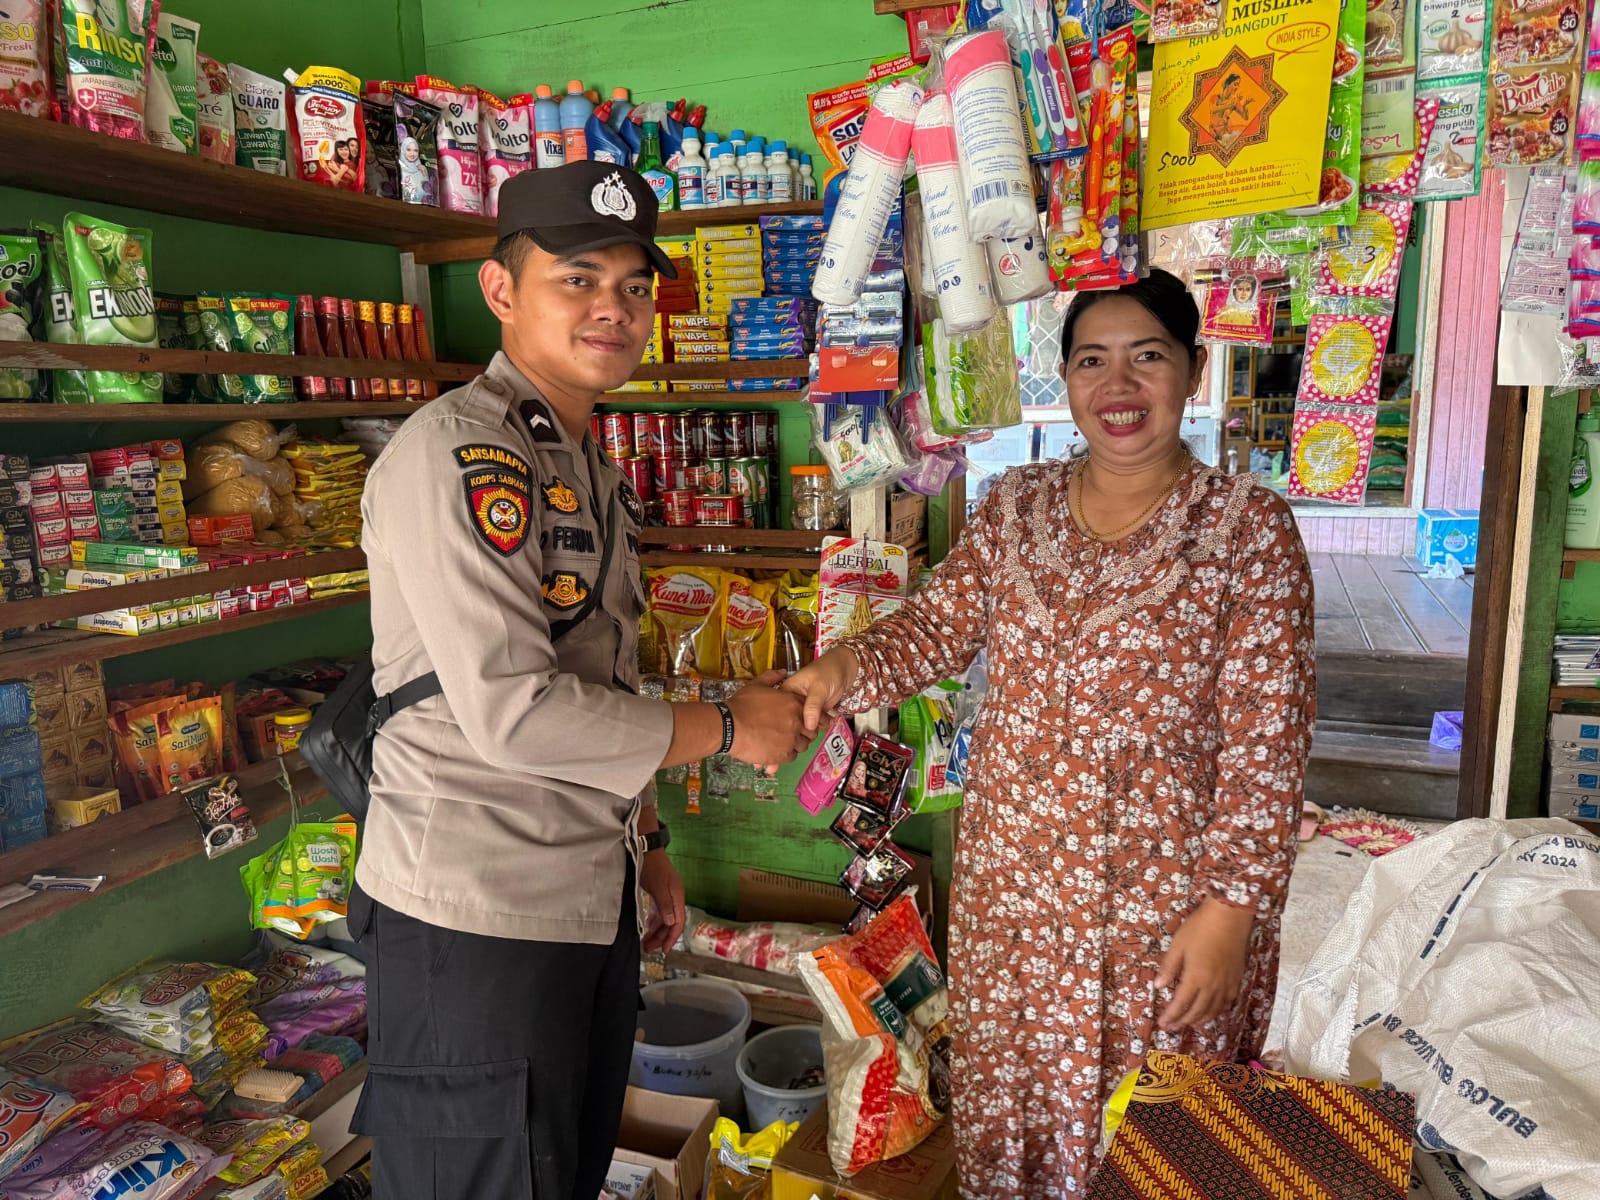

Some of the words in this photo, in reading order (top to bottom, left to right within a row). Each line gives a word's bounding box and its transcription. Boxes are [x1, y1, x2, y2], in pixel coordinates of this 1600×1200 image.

[1451, 9, 1460, 18] 2
[1224, 13, 1288, 38] DANGDUT
[1560, 17, 1577, 29] 30
[1276, 32, 1296, 45] INDIA
[1296, 26, 1321, 40] STYLE
[152, 50, 177, 63] ettol
[239, 93, 280, 110] GUARD
[1500, 72, 1567, 116] BonCabe
[200, 101, 223, 116] oré
[1437, 102, 1472, 119] esaku
[1450, 118, 1475, 132] putih
[1552, 122, 1567, 134] 30
[463, 172, 478, 186] 7X
[1158, 181, 1177, 190] Tidak
[1225, 168, 1248, 178] bahan
[1192, 183, 1205, 192] dan
[685, 316, 710, 328] VAPE
[684, 332, 710, 342] VAPE
[691, 343, 718, 354] VAPE
[460, 447, 528, 477] SATSAMAPTA
[470, 473, 497, 488] KORPS
[497, 477, 528, 494] SABHARA
[853, 547, 876, 558] VEETA
[836, 553, 893, 571] HERBAL
[651, 582, 690, 605] Kunci
[829, 734, 847, 758] Giv
[868, 750, 895, 769] Giv
[1541, 853, 1578, 868] 2024
[1457, 1078, 1538, 1139] BULOG
[94, 1140, 188, 1200] Klin
